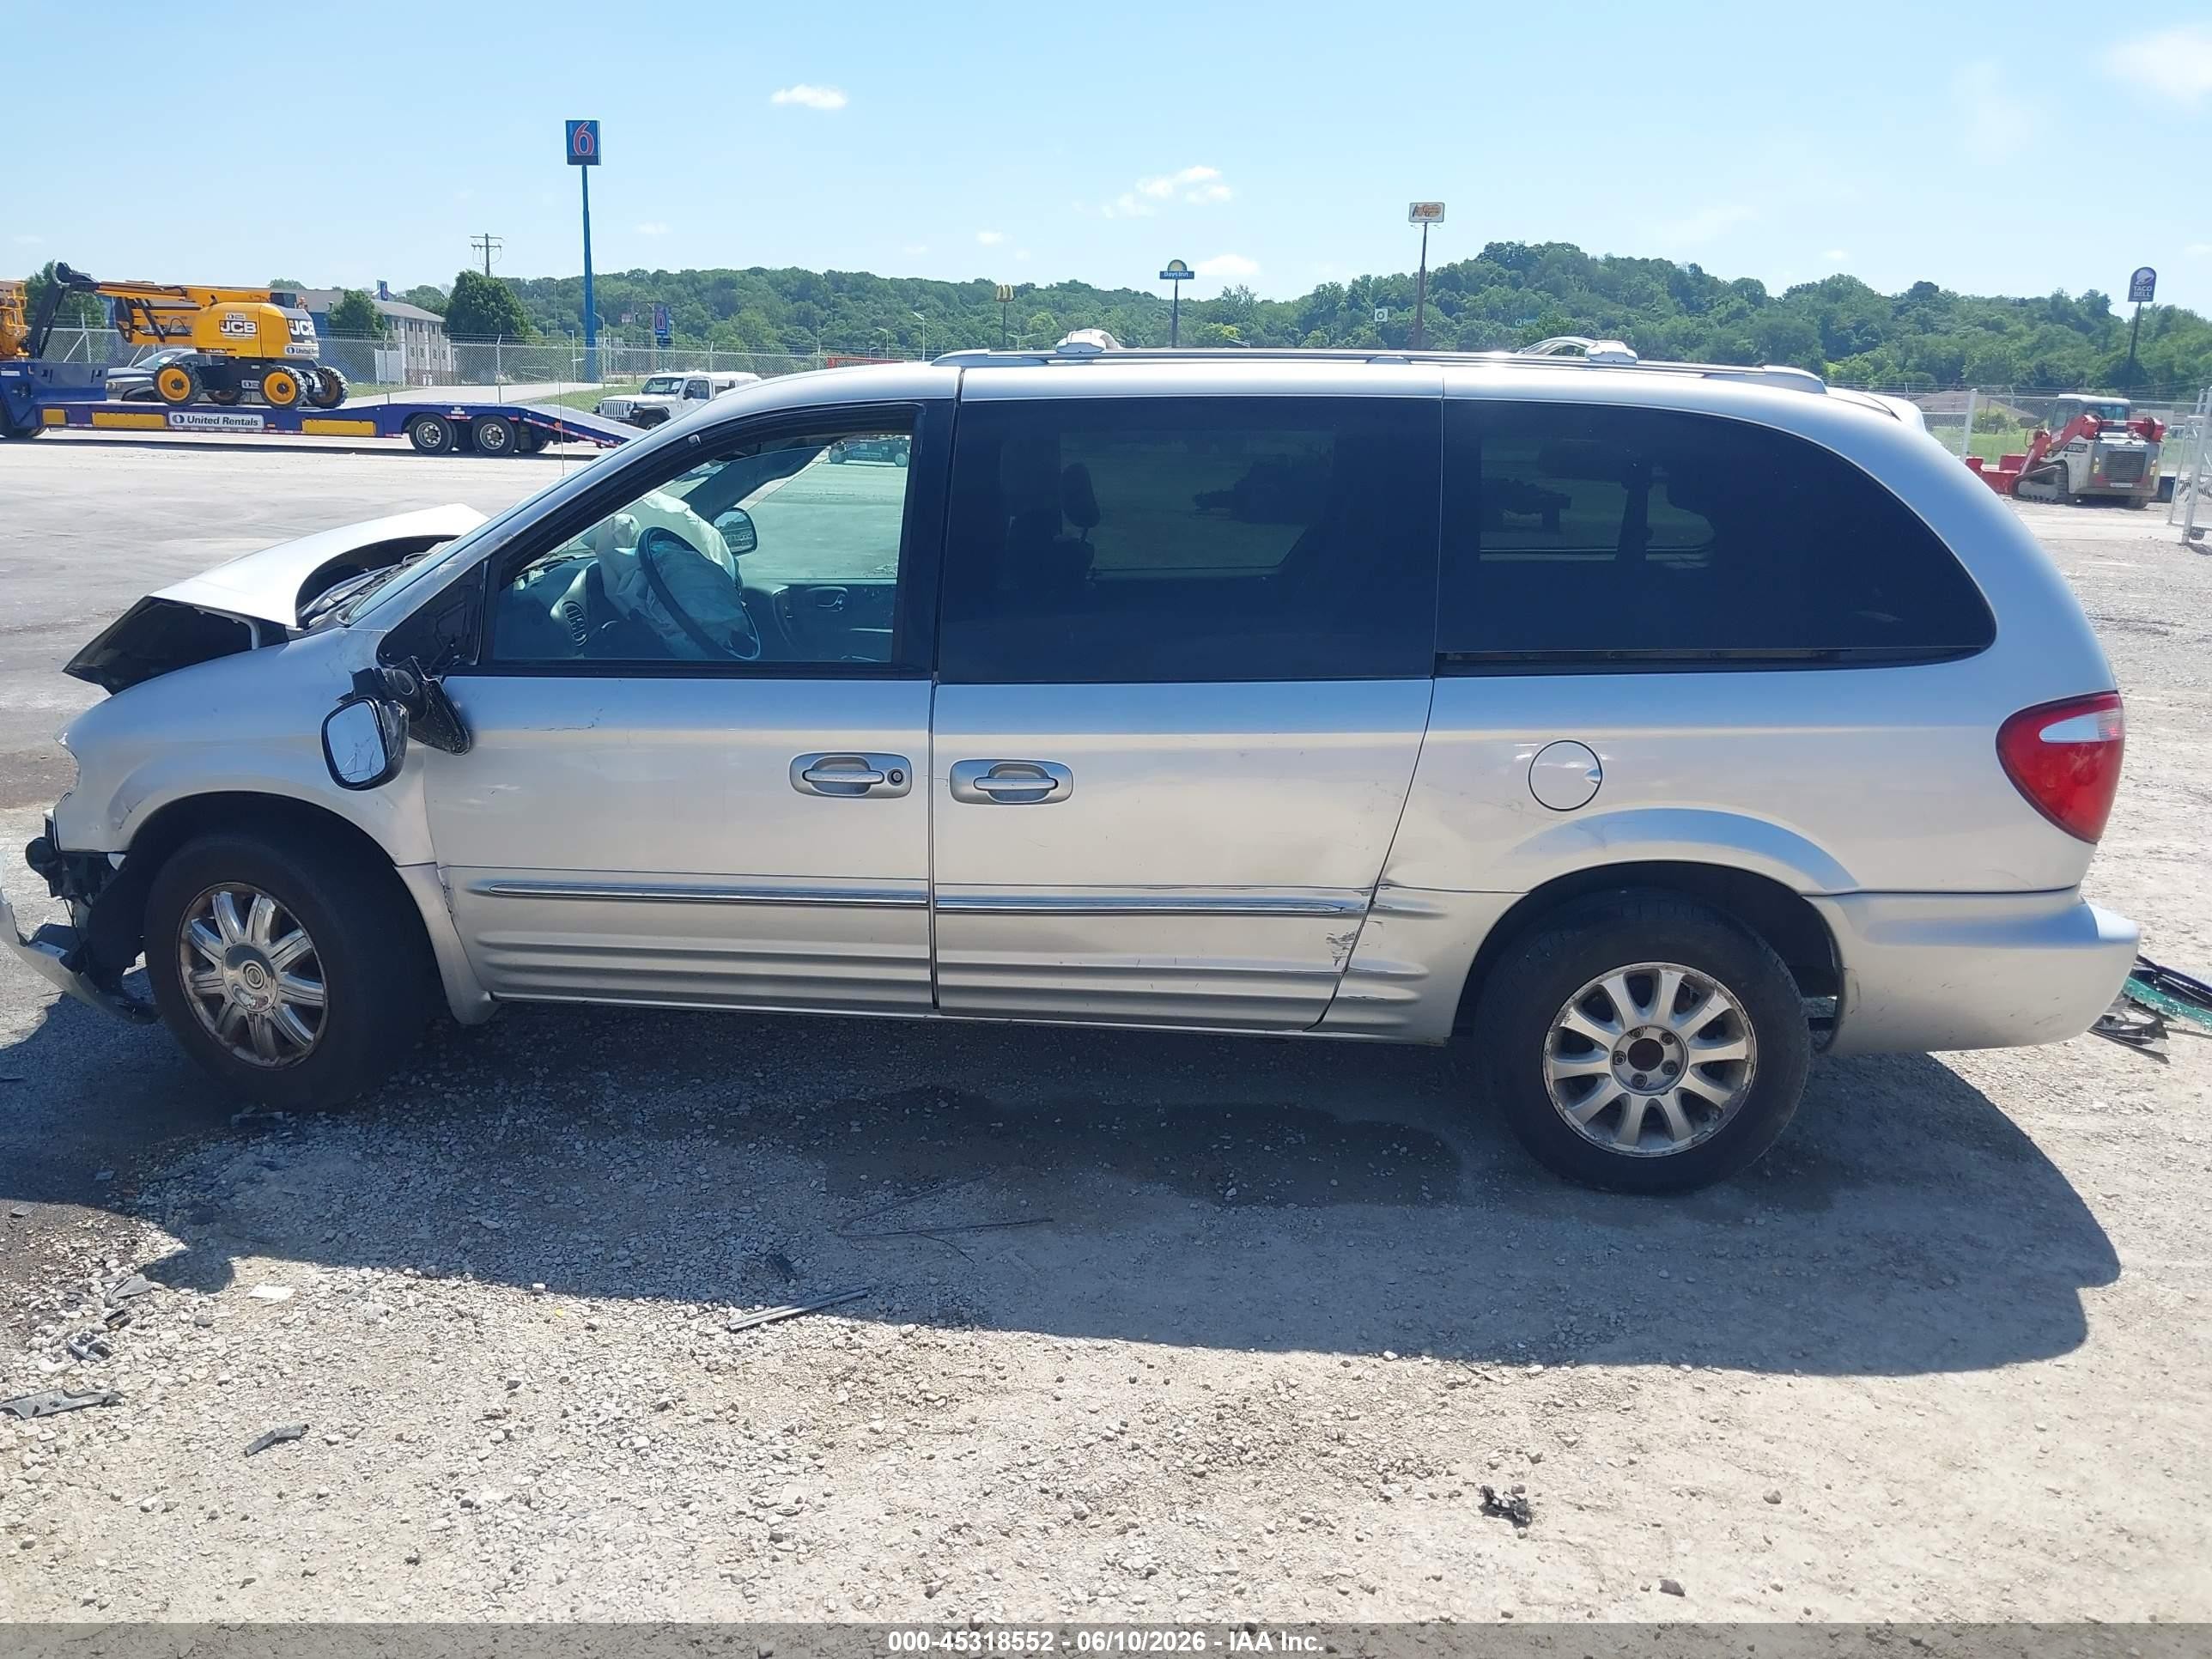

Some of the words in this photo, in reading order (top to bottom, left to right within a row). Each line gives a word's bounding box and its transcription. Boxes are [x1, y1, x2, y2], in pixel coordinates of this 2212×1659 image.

[574, 121, 594, 155] 6
[220, 321, 257, 334] JCB
[289, 319, 315, 336] JCB
[187, 416, 219, 424] United
[222, 416, 258, 426] Rentals
